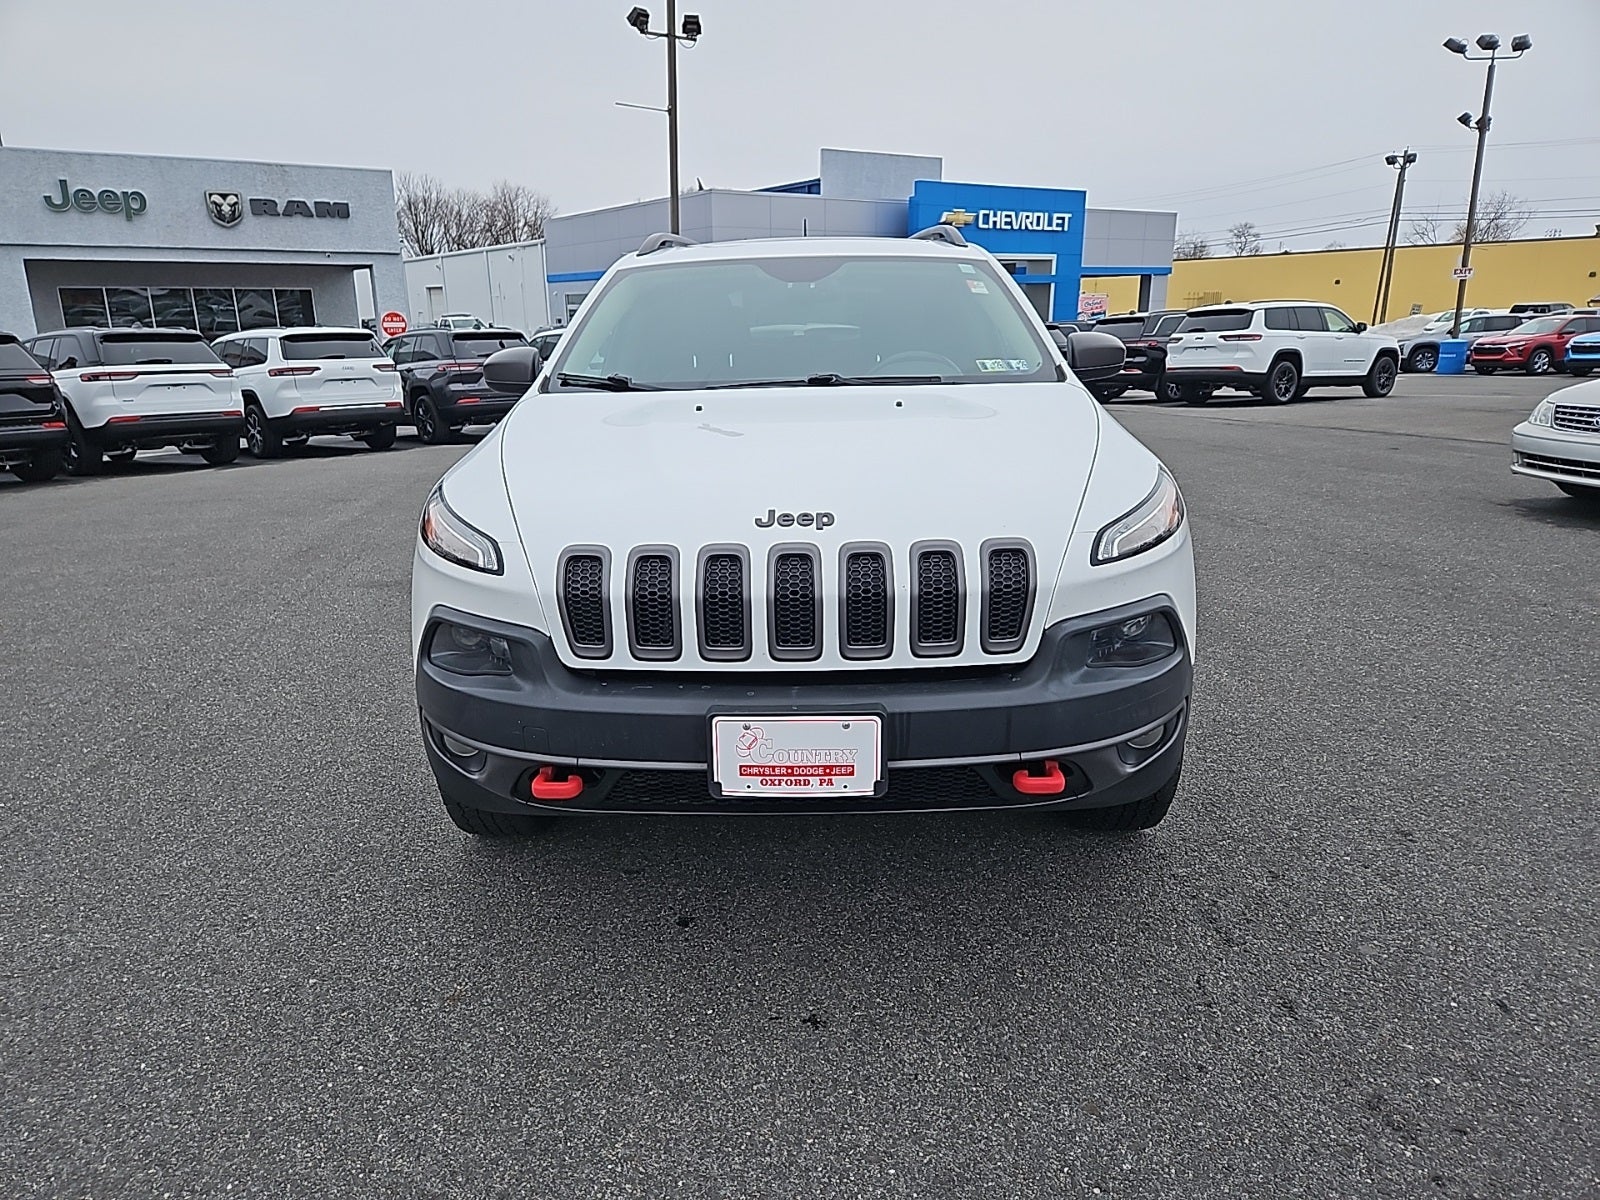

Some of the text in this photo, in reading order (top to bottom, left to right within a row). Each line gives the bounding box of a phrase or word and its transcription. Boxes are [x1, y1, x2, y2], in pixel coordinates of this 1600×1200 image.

[43, 178, 147, 221] Jeep
[249, 197, 350, 219] RAM
[978, 209, 1073, 232] CHEVROLET
[1453, 268, 1473, 276] EXIT
[754, 509, 835, 531] Jeep
[740, 767, 853, 775] CHRYSLER DODGE JEEP
[759, 778, 835, 788] OXFORD, PA
